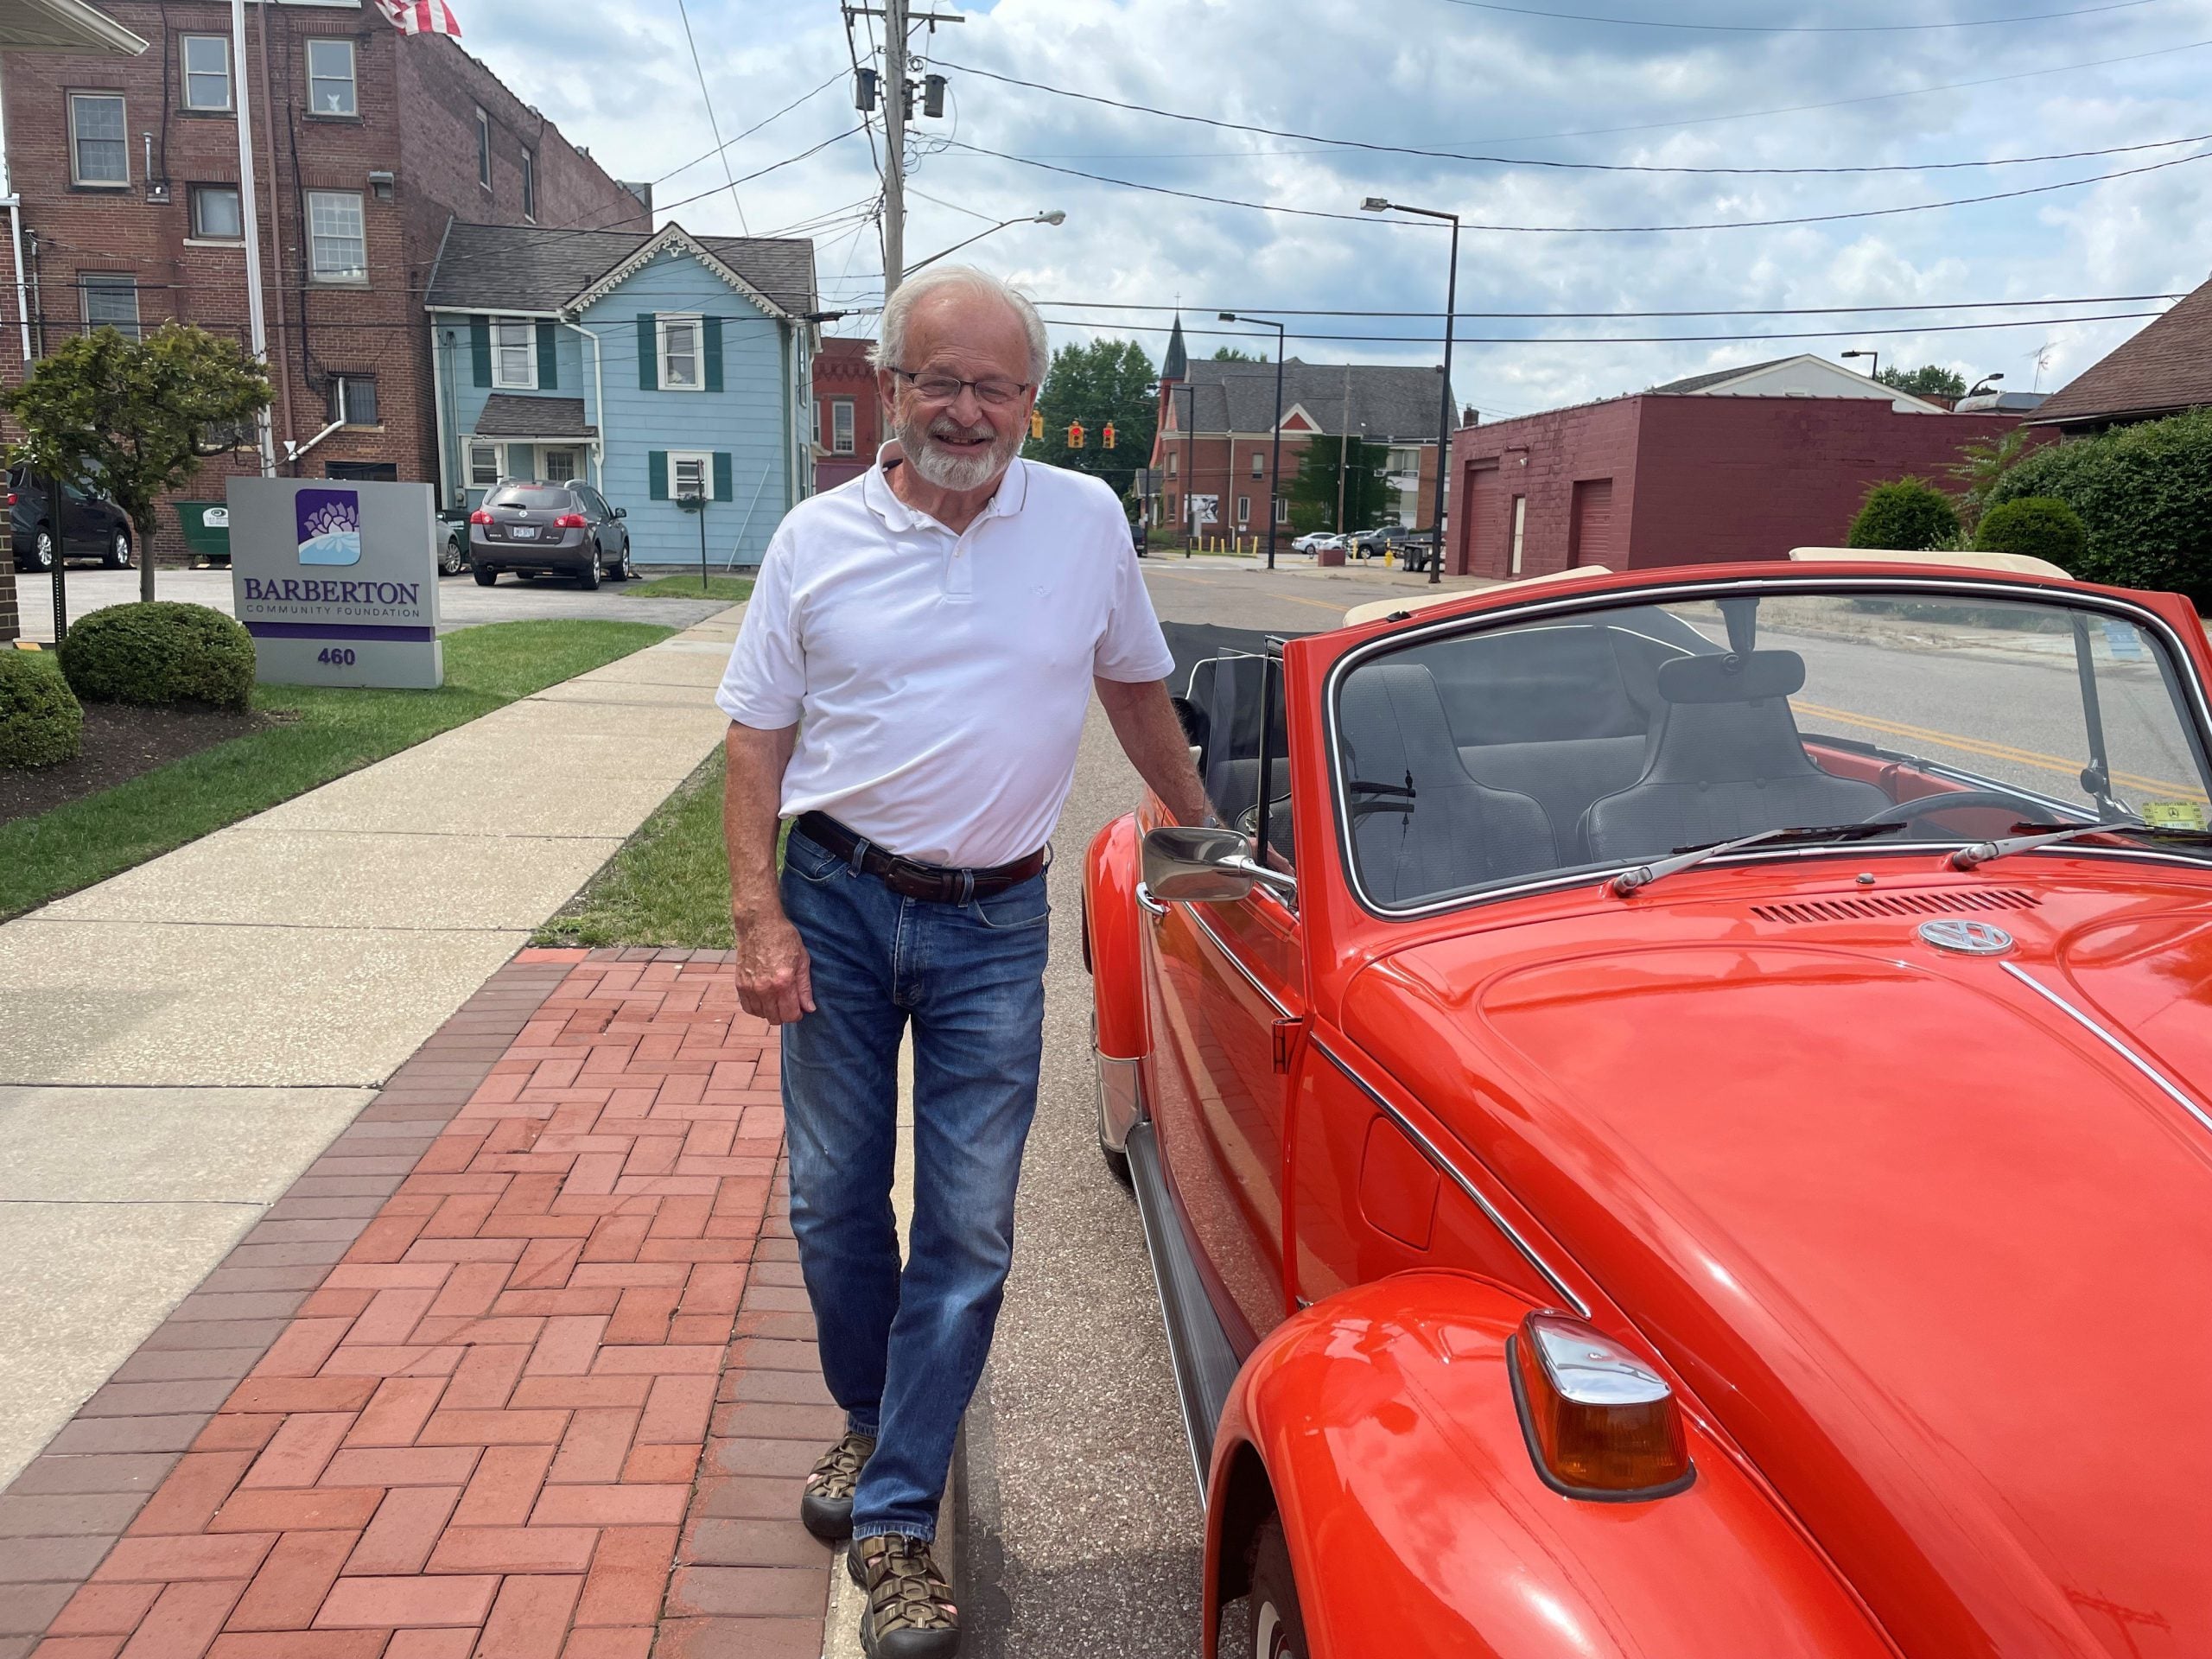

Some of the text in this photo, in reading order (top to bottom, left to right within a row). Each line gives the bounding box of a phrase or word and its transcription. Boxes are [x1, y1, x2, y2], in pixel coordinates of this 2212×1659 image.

[244, 578, 419, 605] BARBERTON
[246, 605, 420, 618] COMMUNITY FOUNDATION
[318, 648, 355, 665] 460
